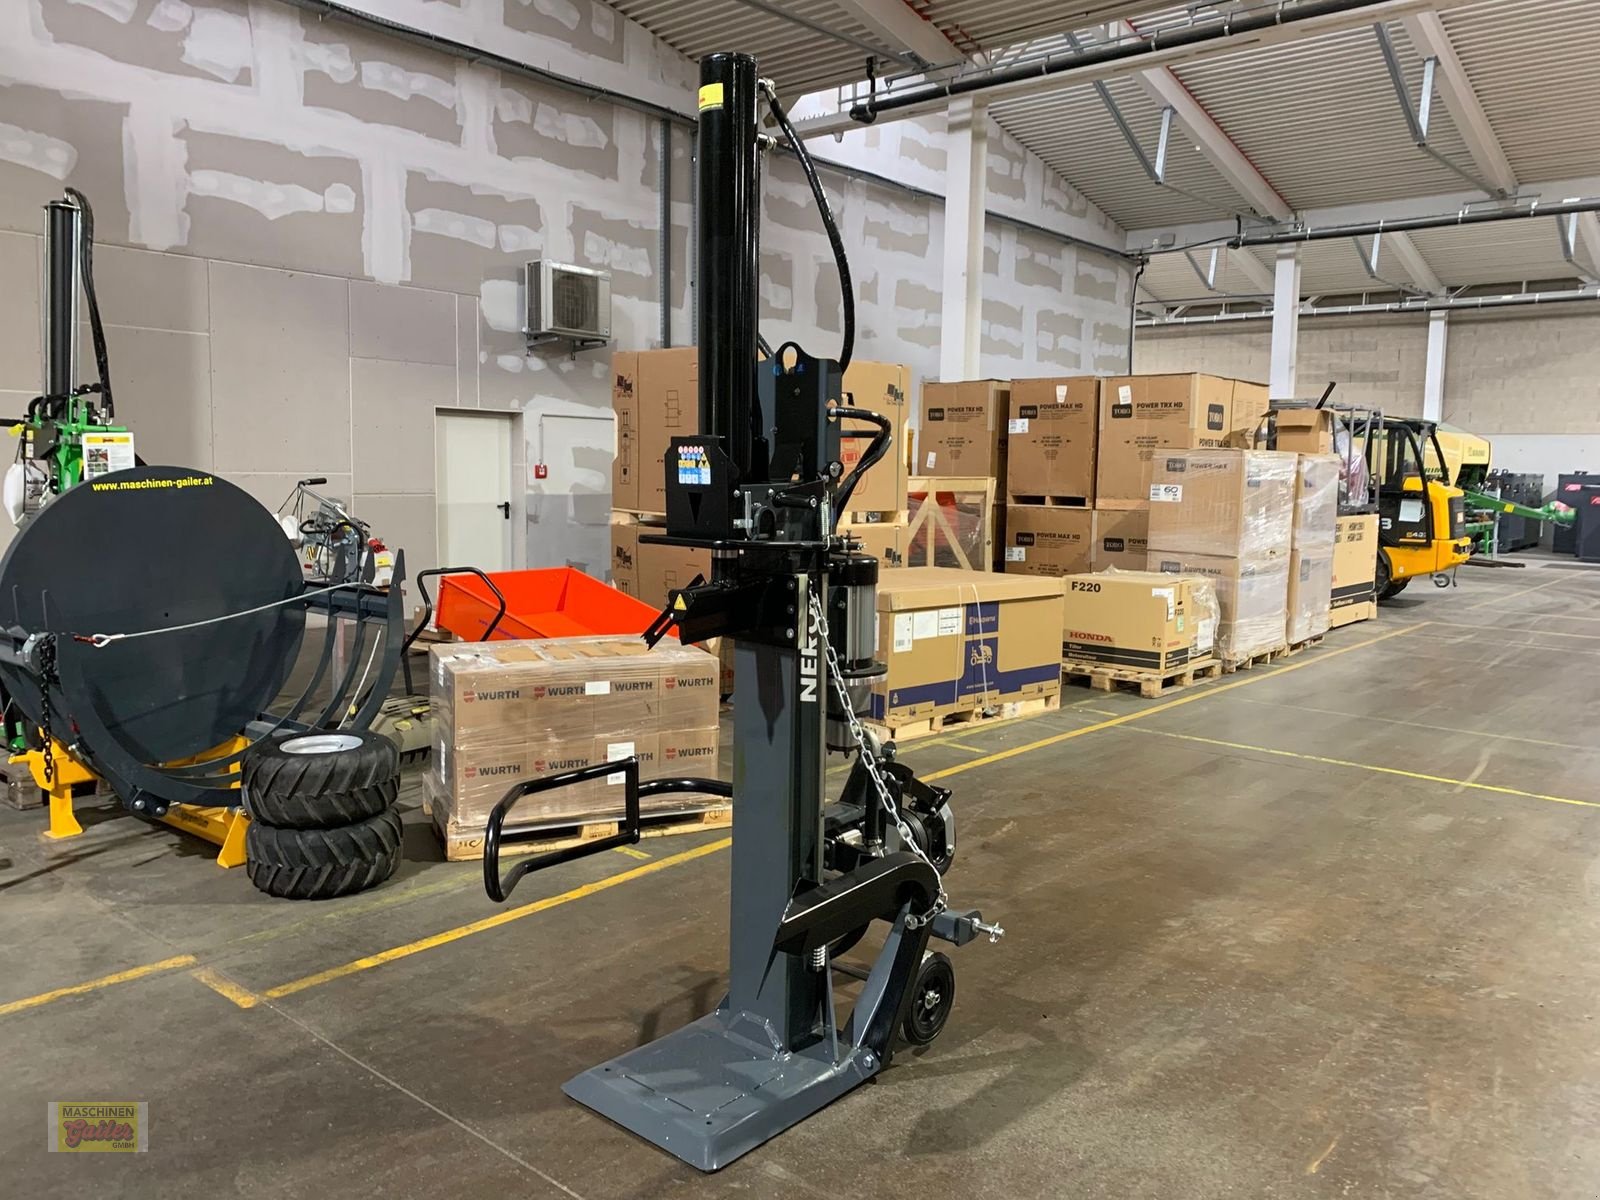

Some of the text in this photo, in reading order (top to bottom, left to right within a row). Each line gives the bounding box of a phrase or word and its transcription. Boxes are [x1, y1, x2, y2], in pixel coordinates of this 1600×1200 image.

[1209, 412, 1222, 423] TORO
[1199, 438, 1214, 447] POWER
[92, 477, 213, 491] www.maschinen-gailer.at
[1163, 486, 1178, 494] 60
[1072, 581, 1101, 593] F220
[1069, 631, 1112, 643] HONDA
